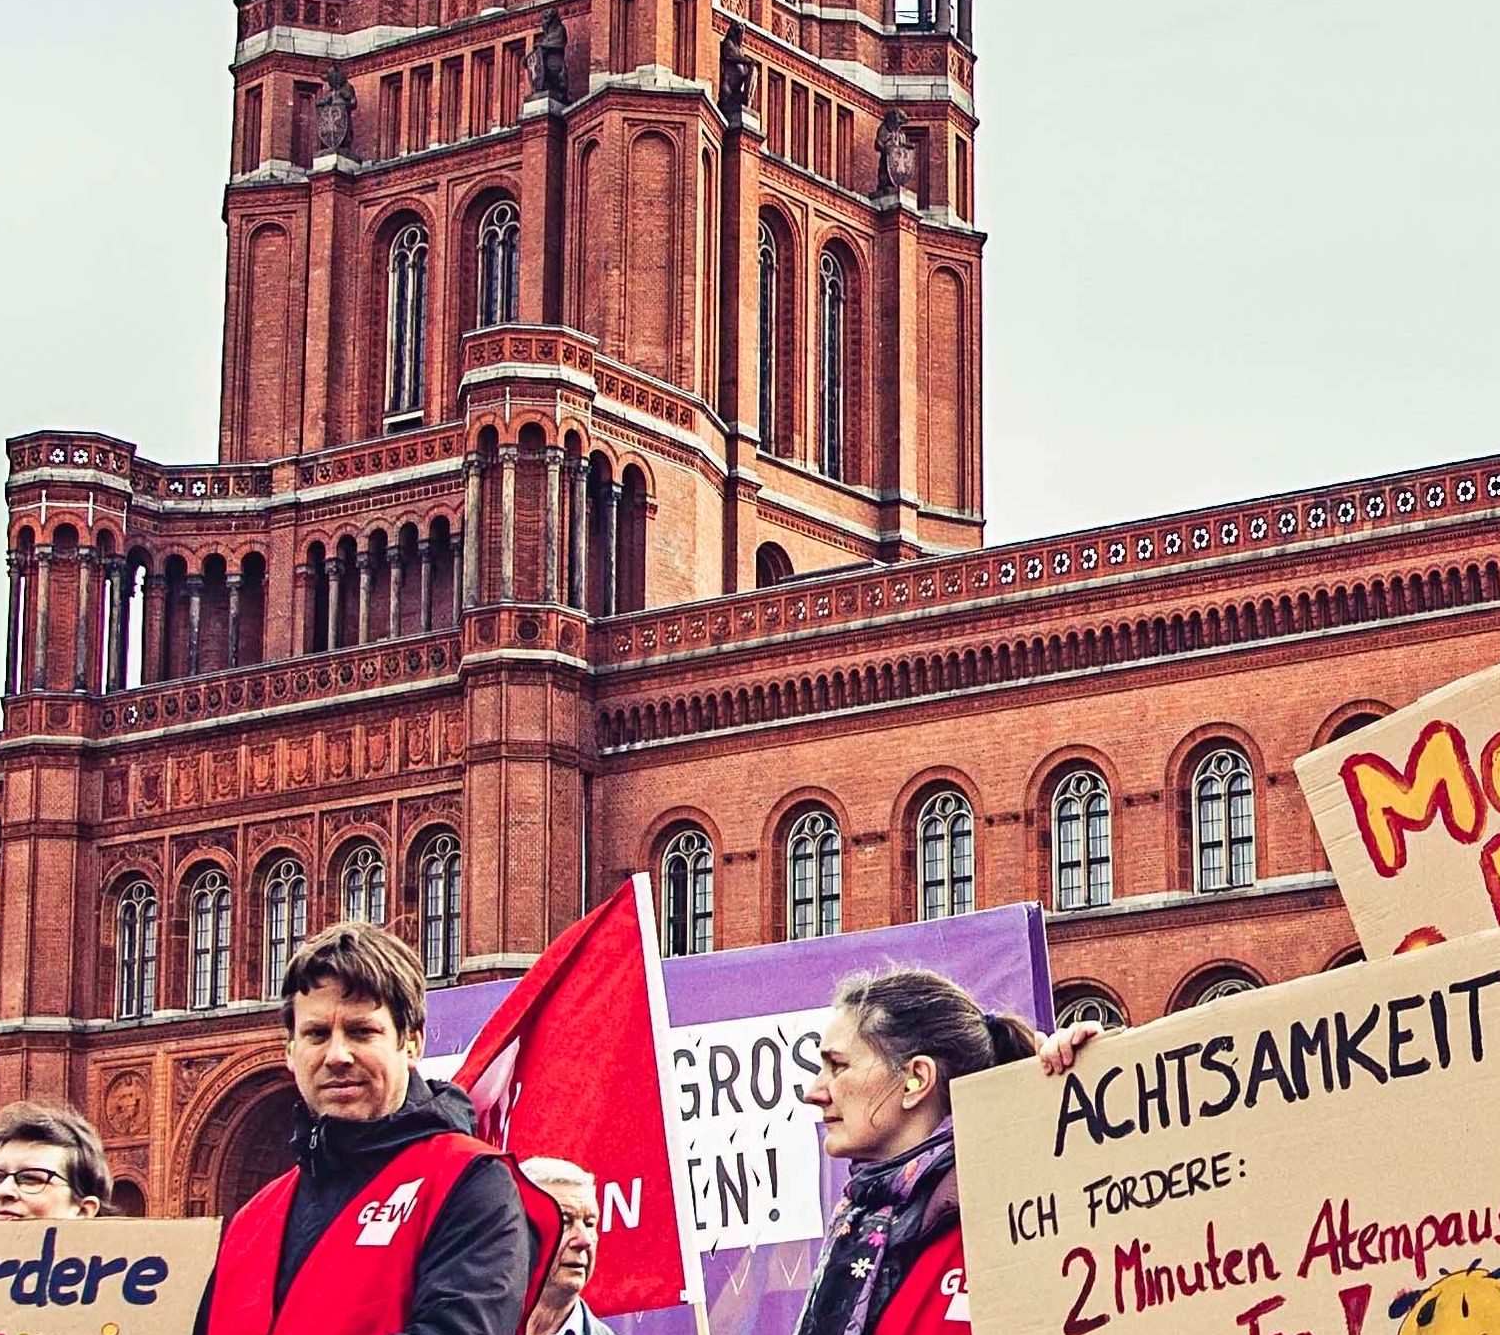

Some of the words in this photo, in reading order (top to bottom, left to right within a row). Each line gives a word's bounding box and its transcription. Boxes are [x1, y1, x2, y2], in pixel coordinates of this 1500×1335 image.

[357, 1196, 418, 1225] GEW
[1008, 1192, 1059, 1246] ICH
[1084, 1153, 1248, 1228] FORDERE:
[1114, 1220, 1282, 1316] Minuten
